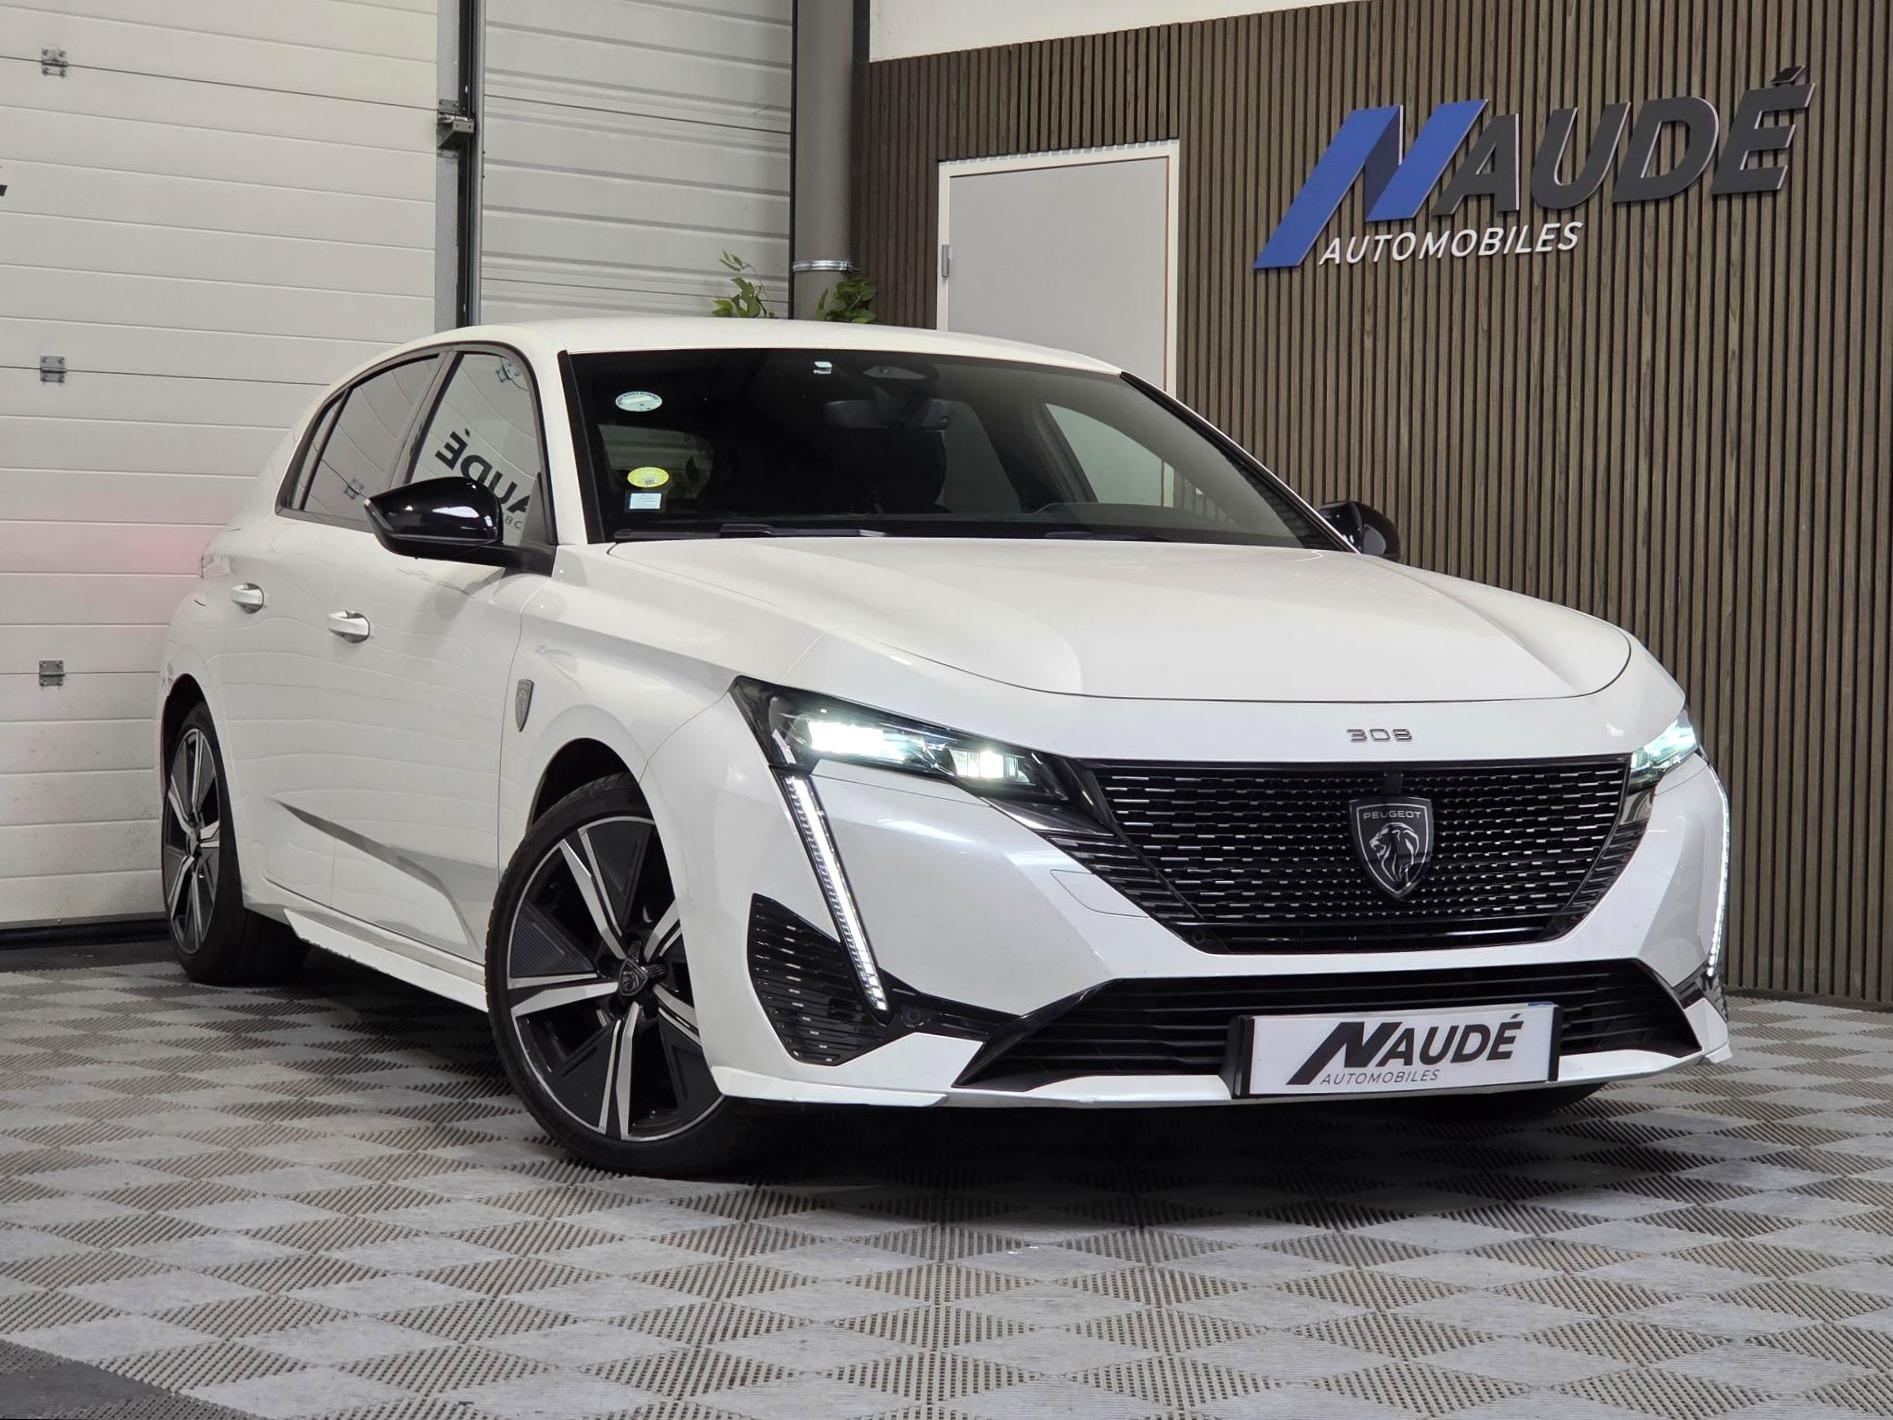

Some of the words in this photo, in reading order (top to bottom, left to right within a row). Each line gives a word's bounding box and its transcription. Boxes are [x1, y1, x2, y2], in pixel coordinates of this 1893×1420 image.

[1254, 65, 1815, 269] NAUDÉ
[1319, 220, 1583, 266] AUTOMOBILES
[1346, 728, 1413, 743] 308
[1362, 810, 1422, 820] PEUGEOT
[1285, 1013, 1525, 1086] NAUDÉ
[1319, 1069, 1441, 1086] AUTOMOBILES
